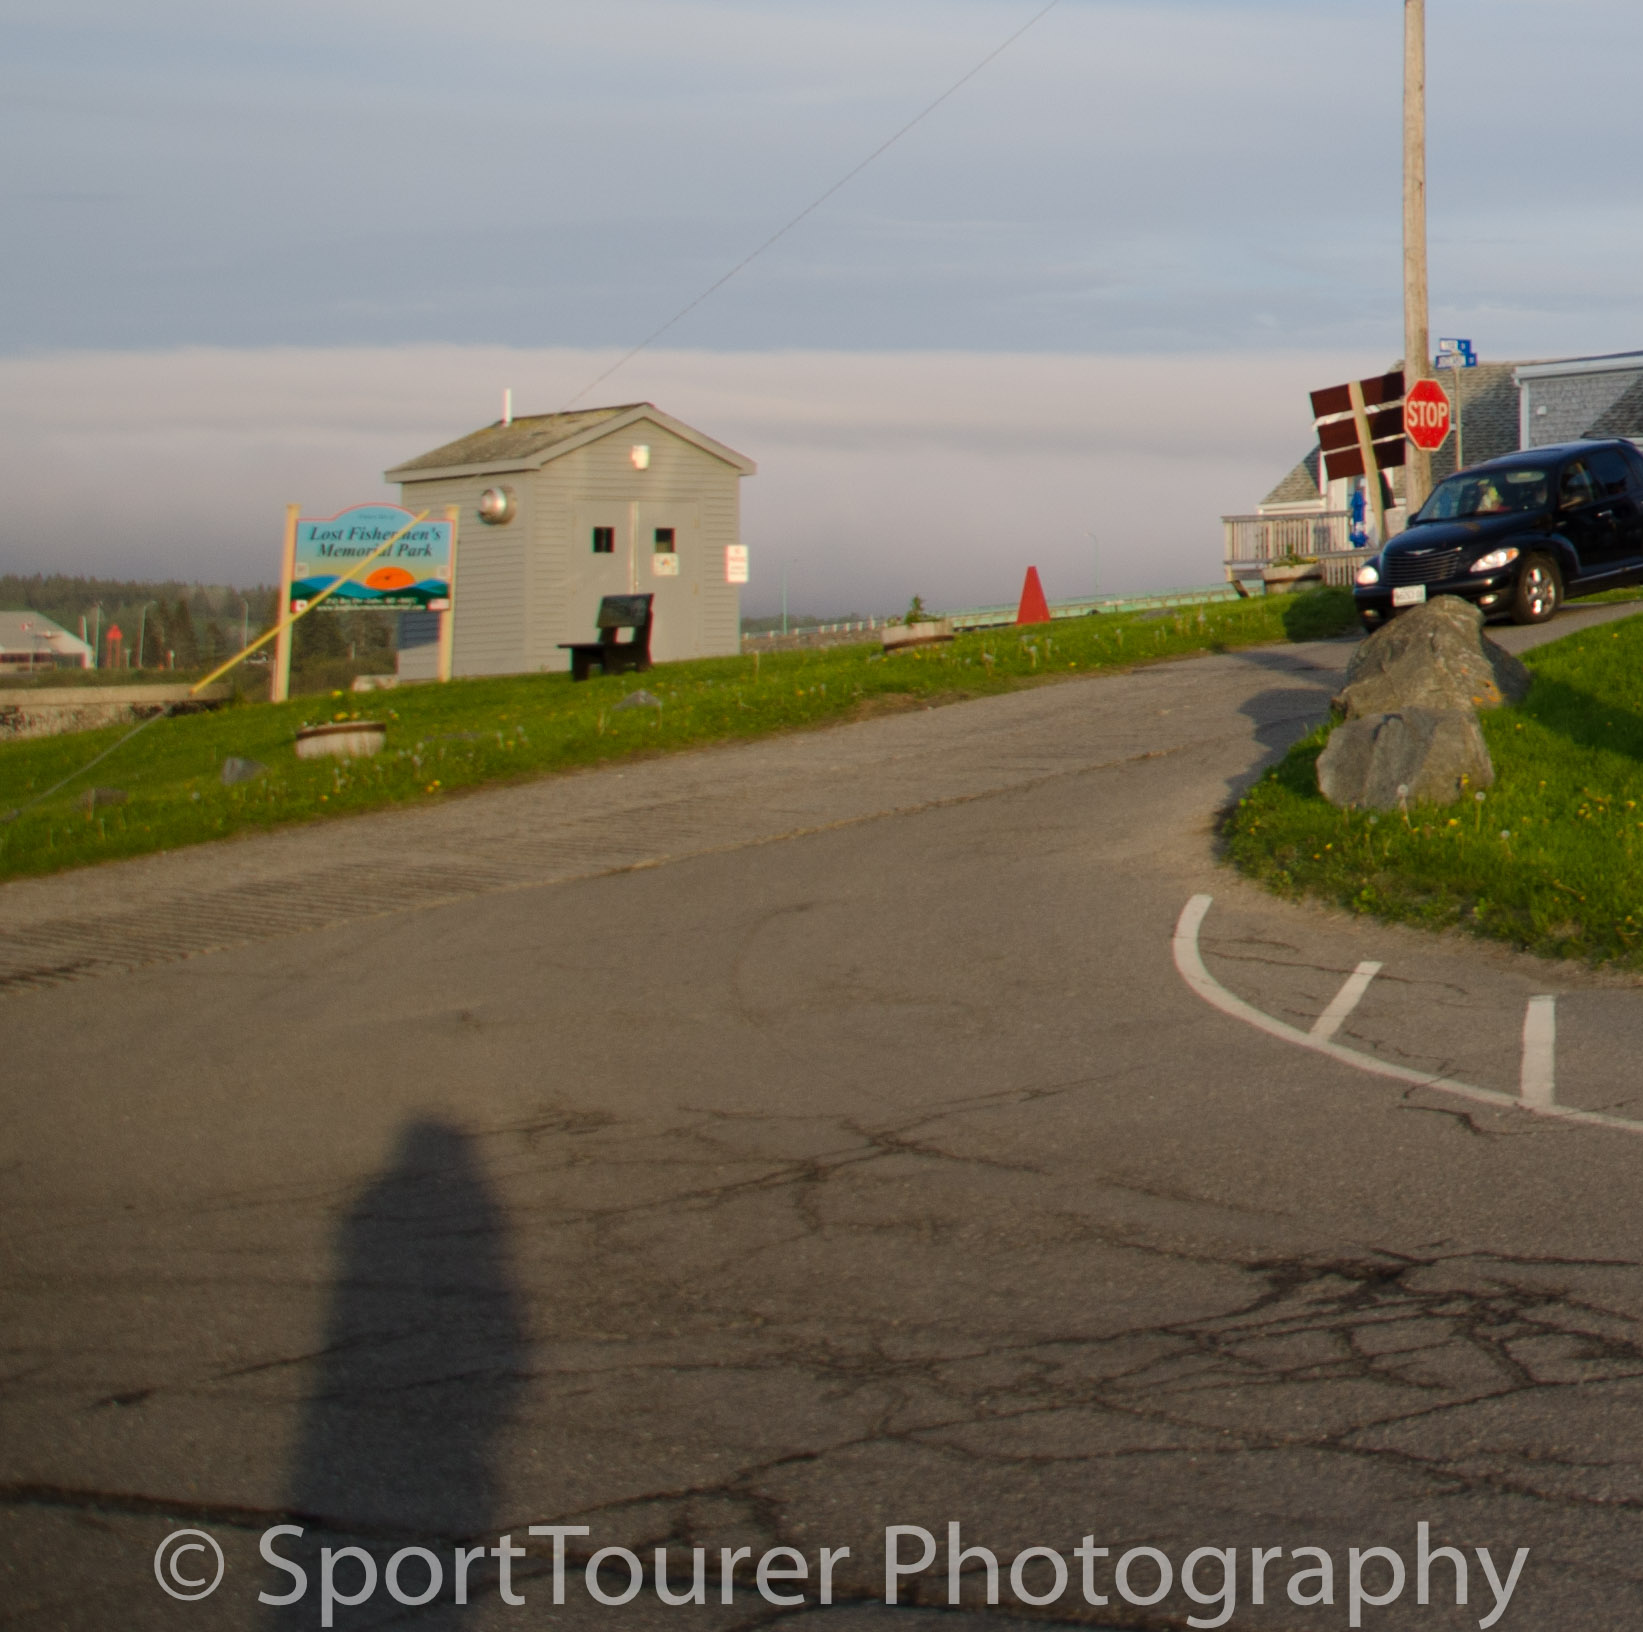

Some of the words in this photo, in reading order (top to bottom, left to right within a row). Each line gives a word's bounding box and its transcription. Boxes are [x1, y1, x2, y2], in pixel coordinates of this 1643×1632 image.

[1408, 401, 1448, 427] STOP
[310, 526, 343, 541] Lost
[397, 543, 433, 558] Park
